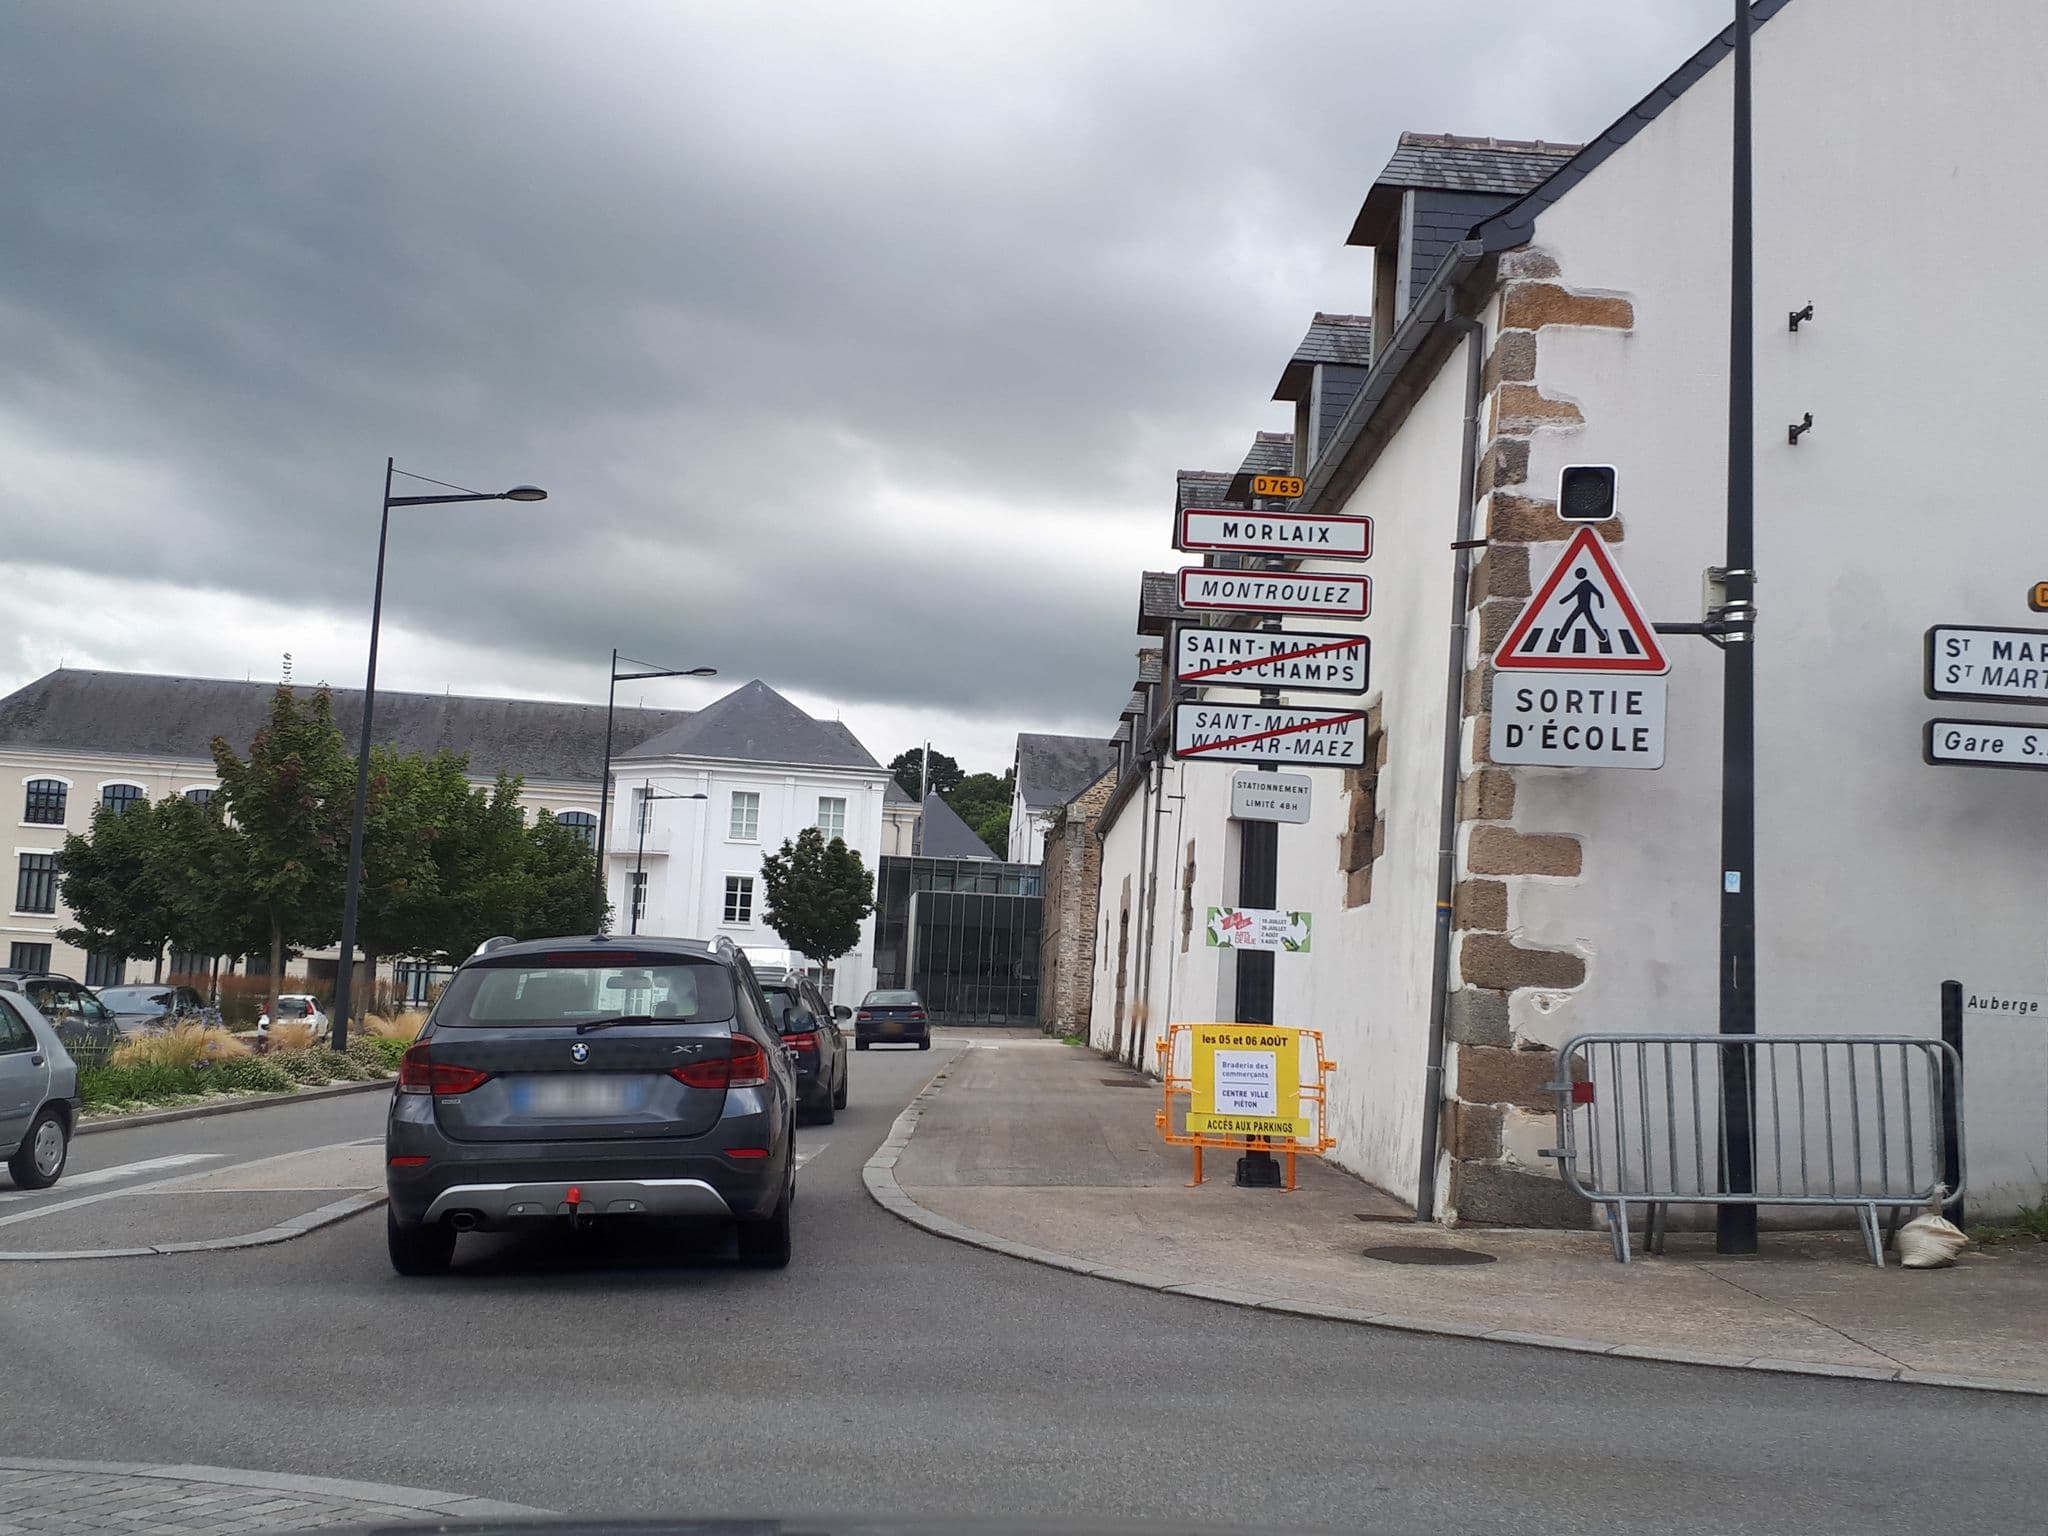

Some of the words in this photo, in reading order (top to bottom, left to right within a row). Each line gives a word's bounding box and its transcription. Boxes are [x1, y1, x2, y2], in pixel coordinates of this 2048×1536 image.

[1223, 522, 1330, 543] MORLAIX
[1201, 581, 1350, 603] MONTROULEZ
[1187, 636, 1359, 661] SAINT-MARTIN
[1516, 688, 1643, 715] SORTIE
[1195, 712, 1350, 736] SANT-MARTIN
[1506, 719, 1649, 752] D'ÉCOLE
[1945, 731, 2004, 753] Gare
[1237, 781, 1309, 794] STATIONNEMENT
[1246, 799, 1275, 809] LIMITÉ
[1968, 995, 2039, 1014] Auberge
[1202, 1034, 1216, 1044] les
[1219, 1035, 1230, 1044] 05
[1233, 1036, 1242, 1045] et
[1245, 1036, 1257, 1046] 06
[1222, 1061, 1253, 1069] Braderie
[1222, 1071, 1269, 1079] commerçants
[1222, 1090, 1248, 1098] CENTRE
[1250, 1091, 1269, 1099] VILLE
[1233, 1099, 1257, 1108] PIÉTON
[1235, 1120, 1251, 1131] AUX
[1253, 1121, 1293, 1133] PARKINGS
